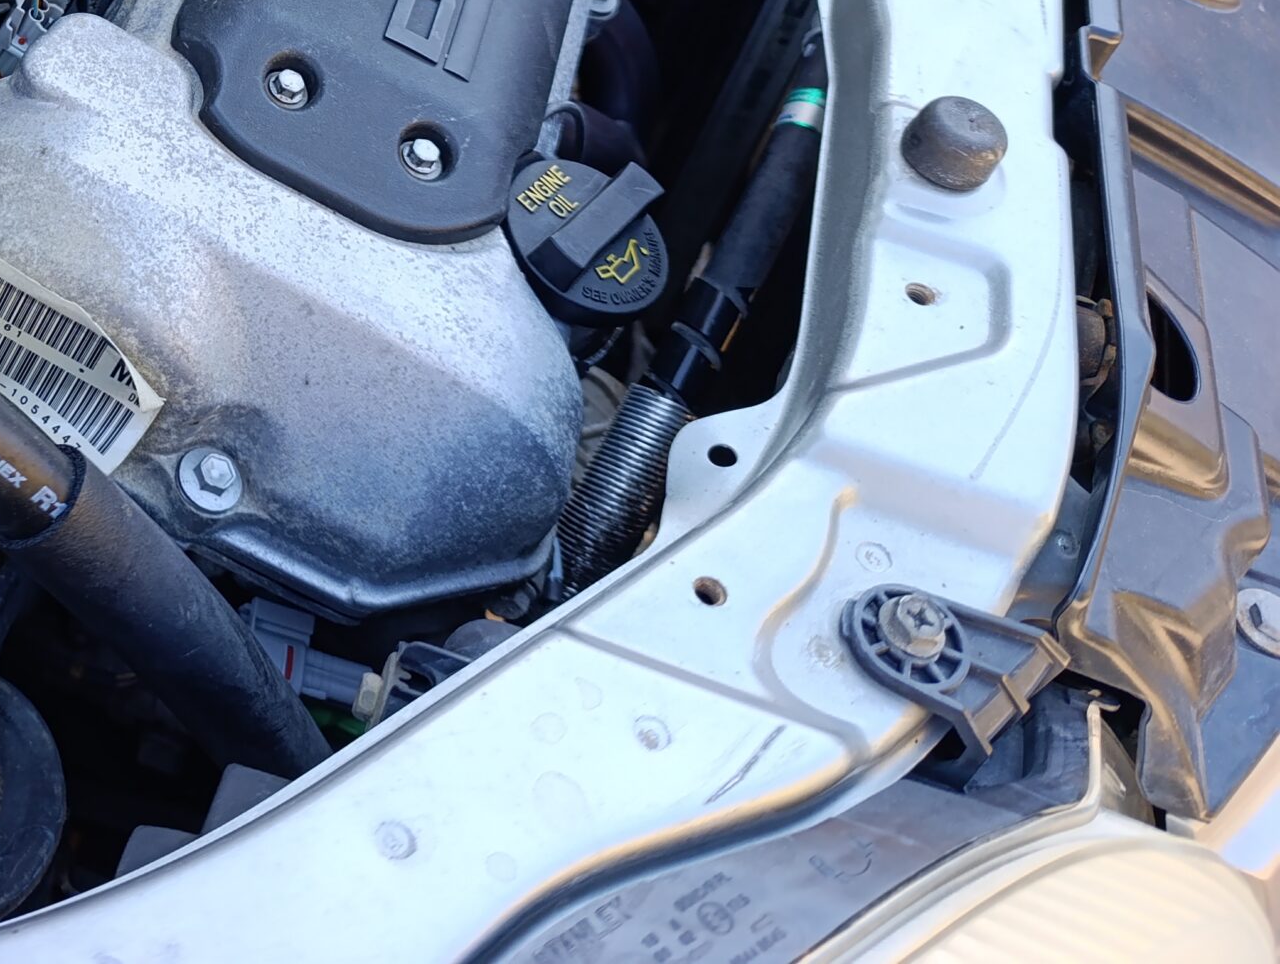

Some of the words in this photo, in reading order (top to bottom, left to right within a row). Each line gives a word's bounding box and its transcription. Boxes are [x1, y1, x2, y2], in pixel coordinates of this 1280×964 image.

[516, 164, 571, 213] ENGINE
[548, 194, 579, 218] OIL
[582, 286, 608, 304] SEE
